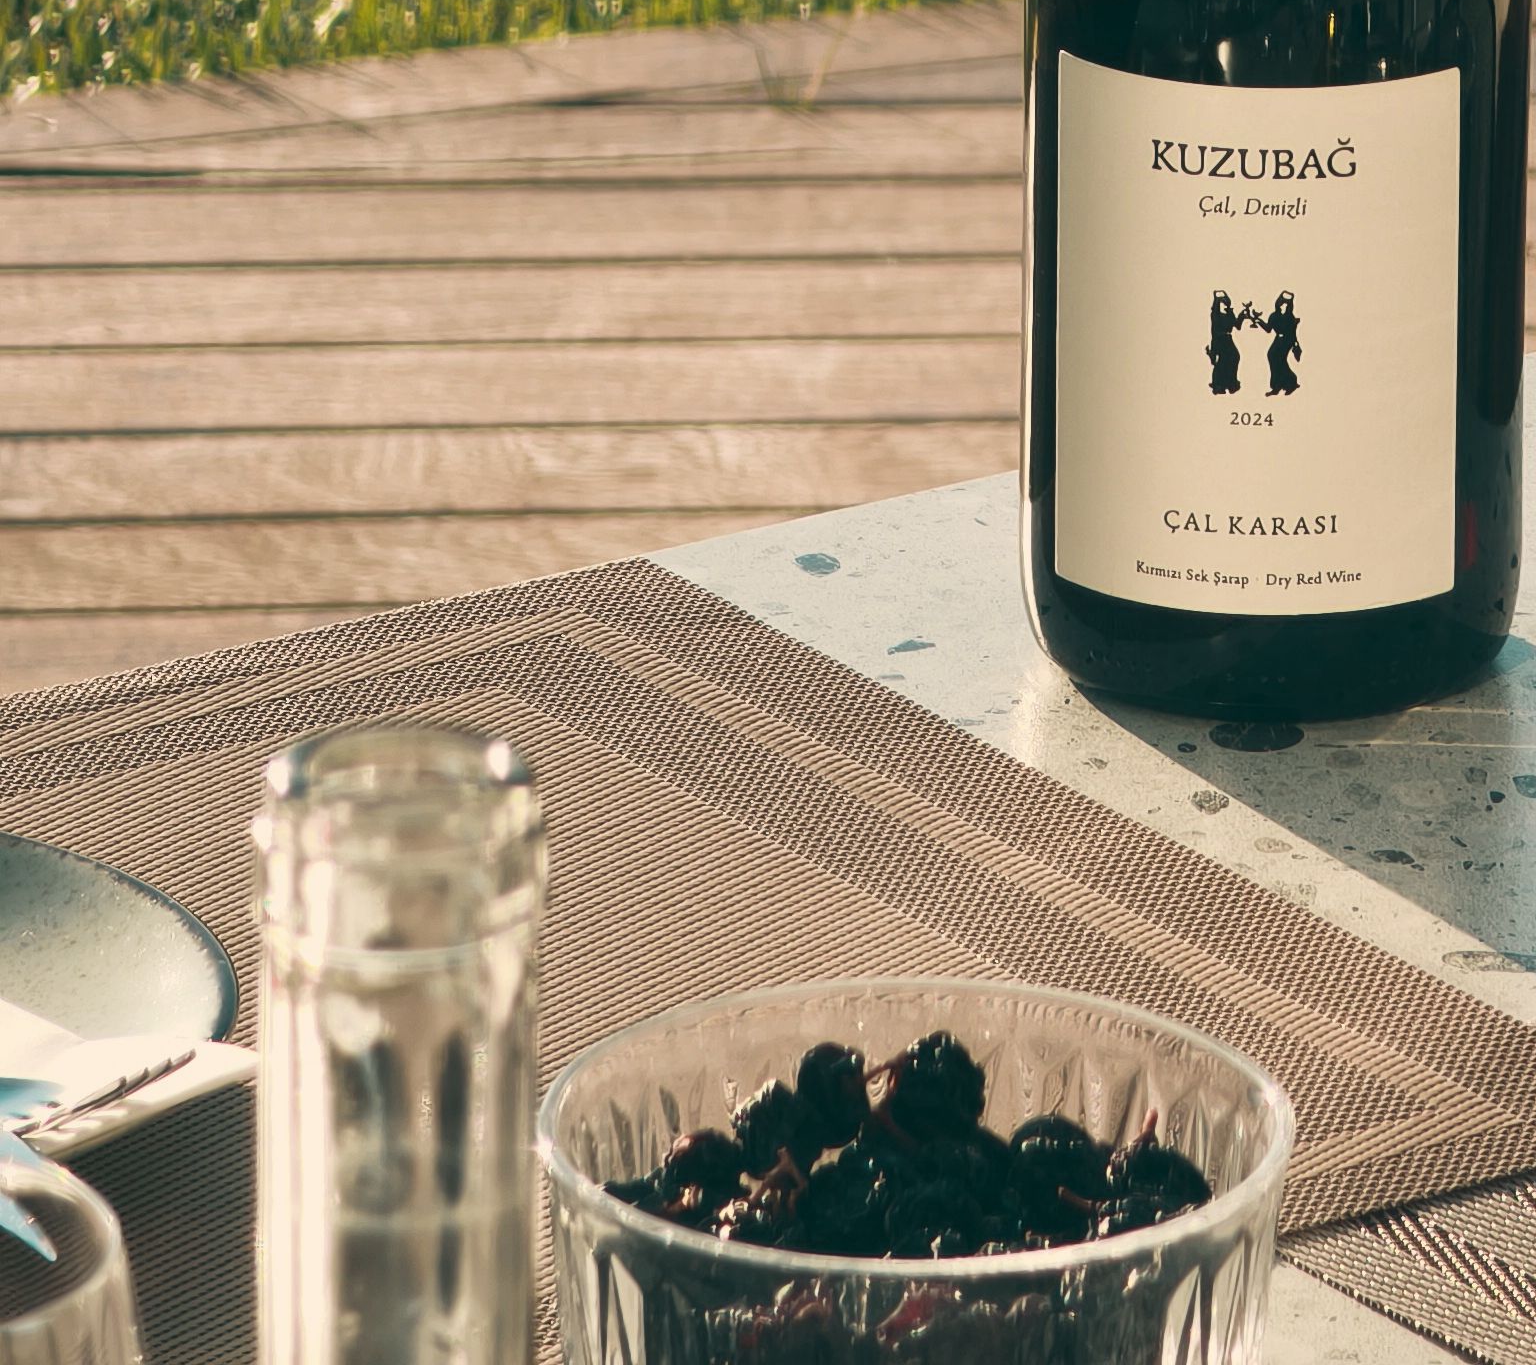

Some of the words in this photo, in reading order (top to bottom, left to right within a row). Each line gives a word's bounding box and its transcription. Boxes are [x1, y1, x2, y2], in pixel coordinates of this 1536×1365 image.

[1151, 136, 1357, 180] KUZUBAĞ
[1198, 195, 1237, 218] Çal,
[1243, 197, 1308, 219] Denizli
[1229, 411, 1275, 427] 2024
[1163, 509, 1218, 534] ÇAL
[1228, 514, 1338, 536] KARASI
[1186, 568, 1209, 583] Sek
[1213, 571, 1250, 590] Şarap
[1265, 573, 1292, 590] Dry
[1296, 570, 1323, 586] Red
[1327, 570, 1362, 585] Wine
